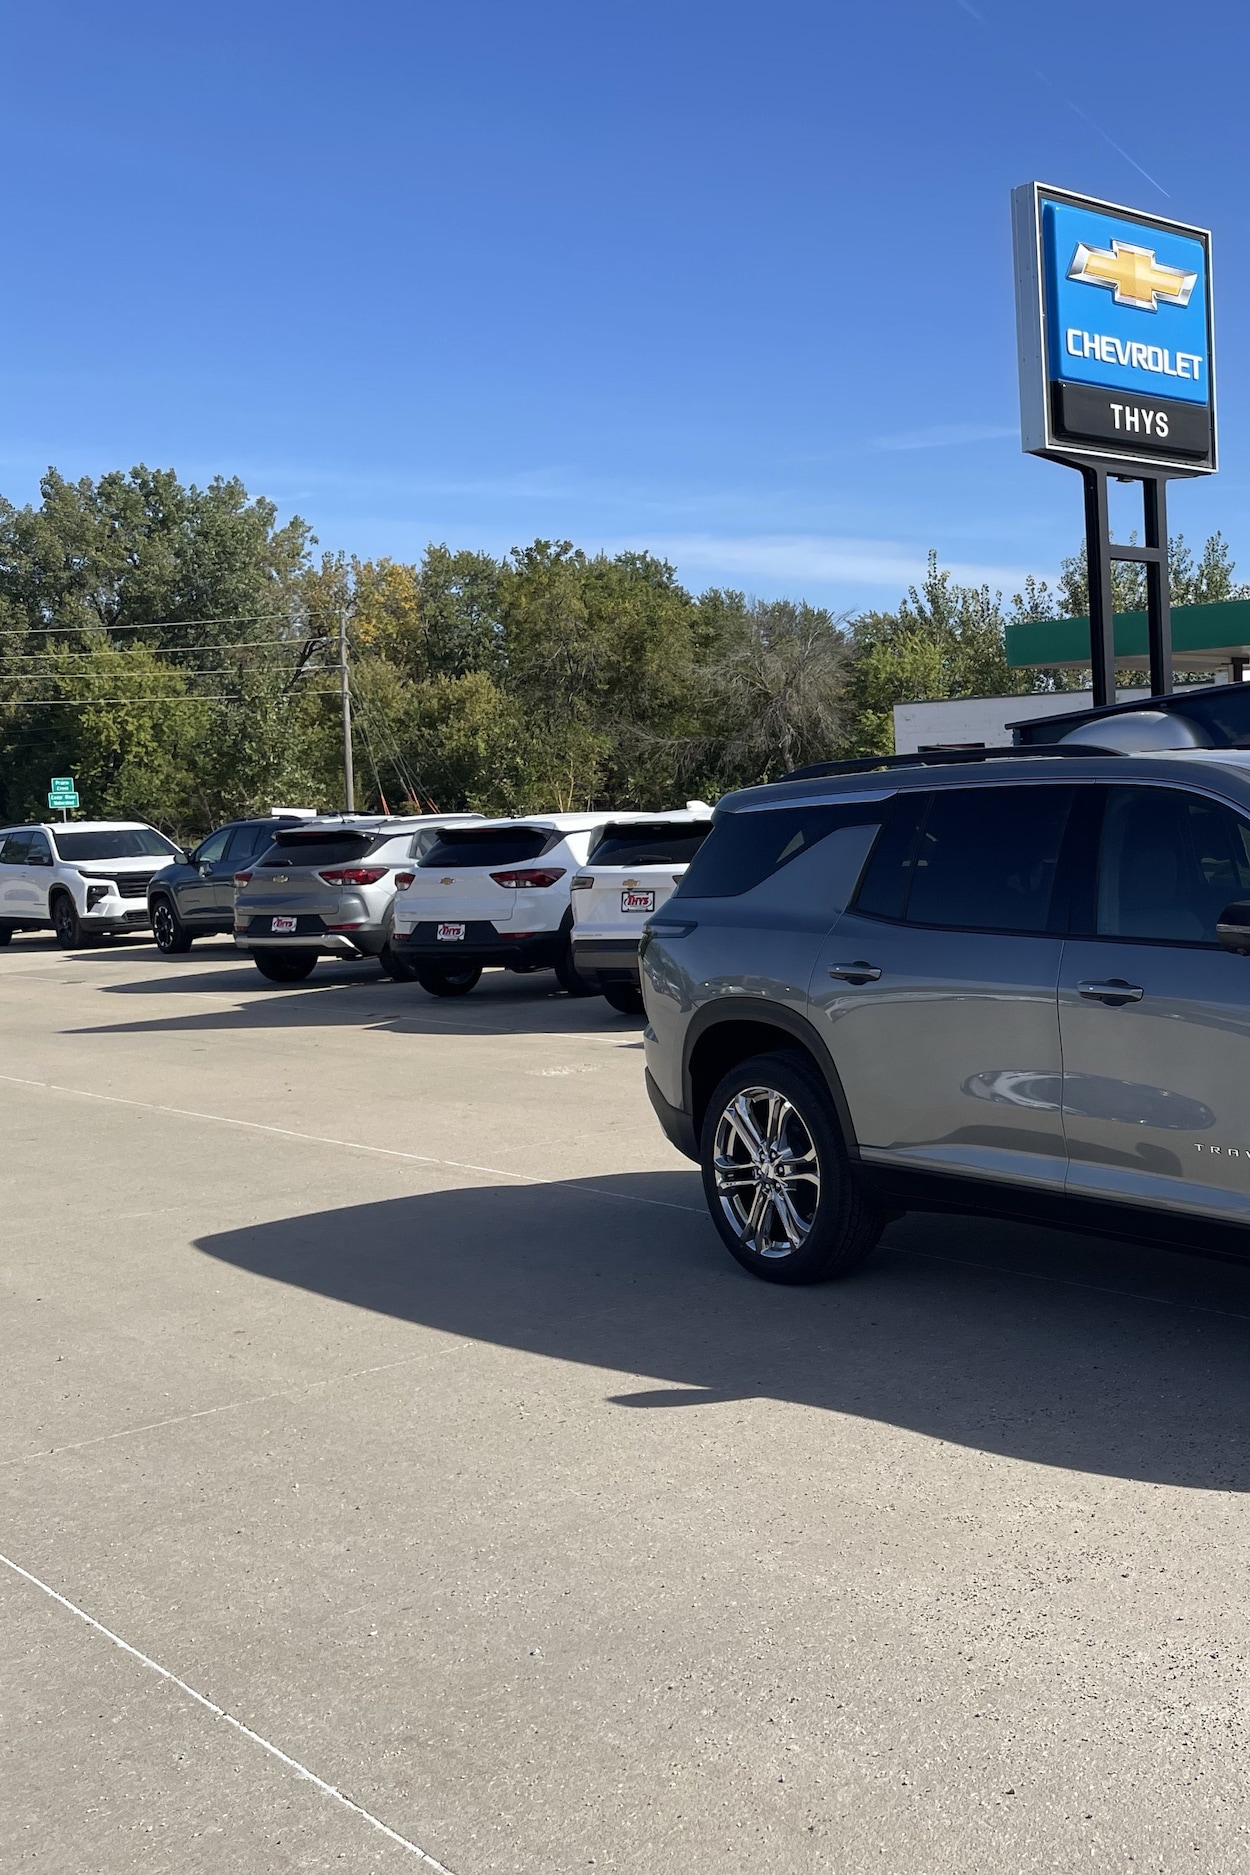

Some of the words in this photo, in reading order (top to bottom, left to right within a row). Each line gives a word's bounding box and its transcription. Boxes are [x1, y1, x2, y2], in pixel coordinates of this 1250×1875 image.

[1066, 329, 1203, 381] CHEVROLET
[1110, 403, 1169, 438] THYS
[627, 894, 650, 906] THYS
